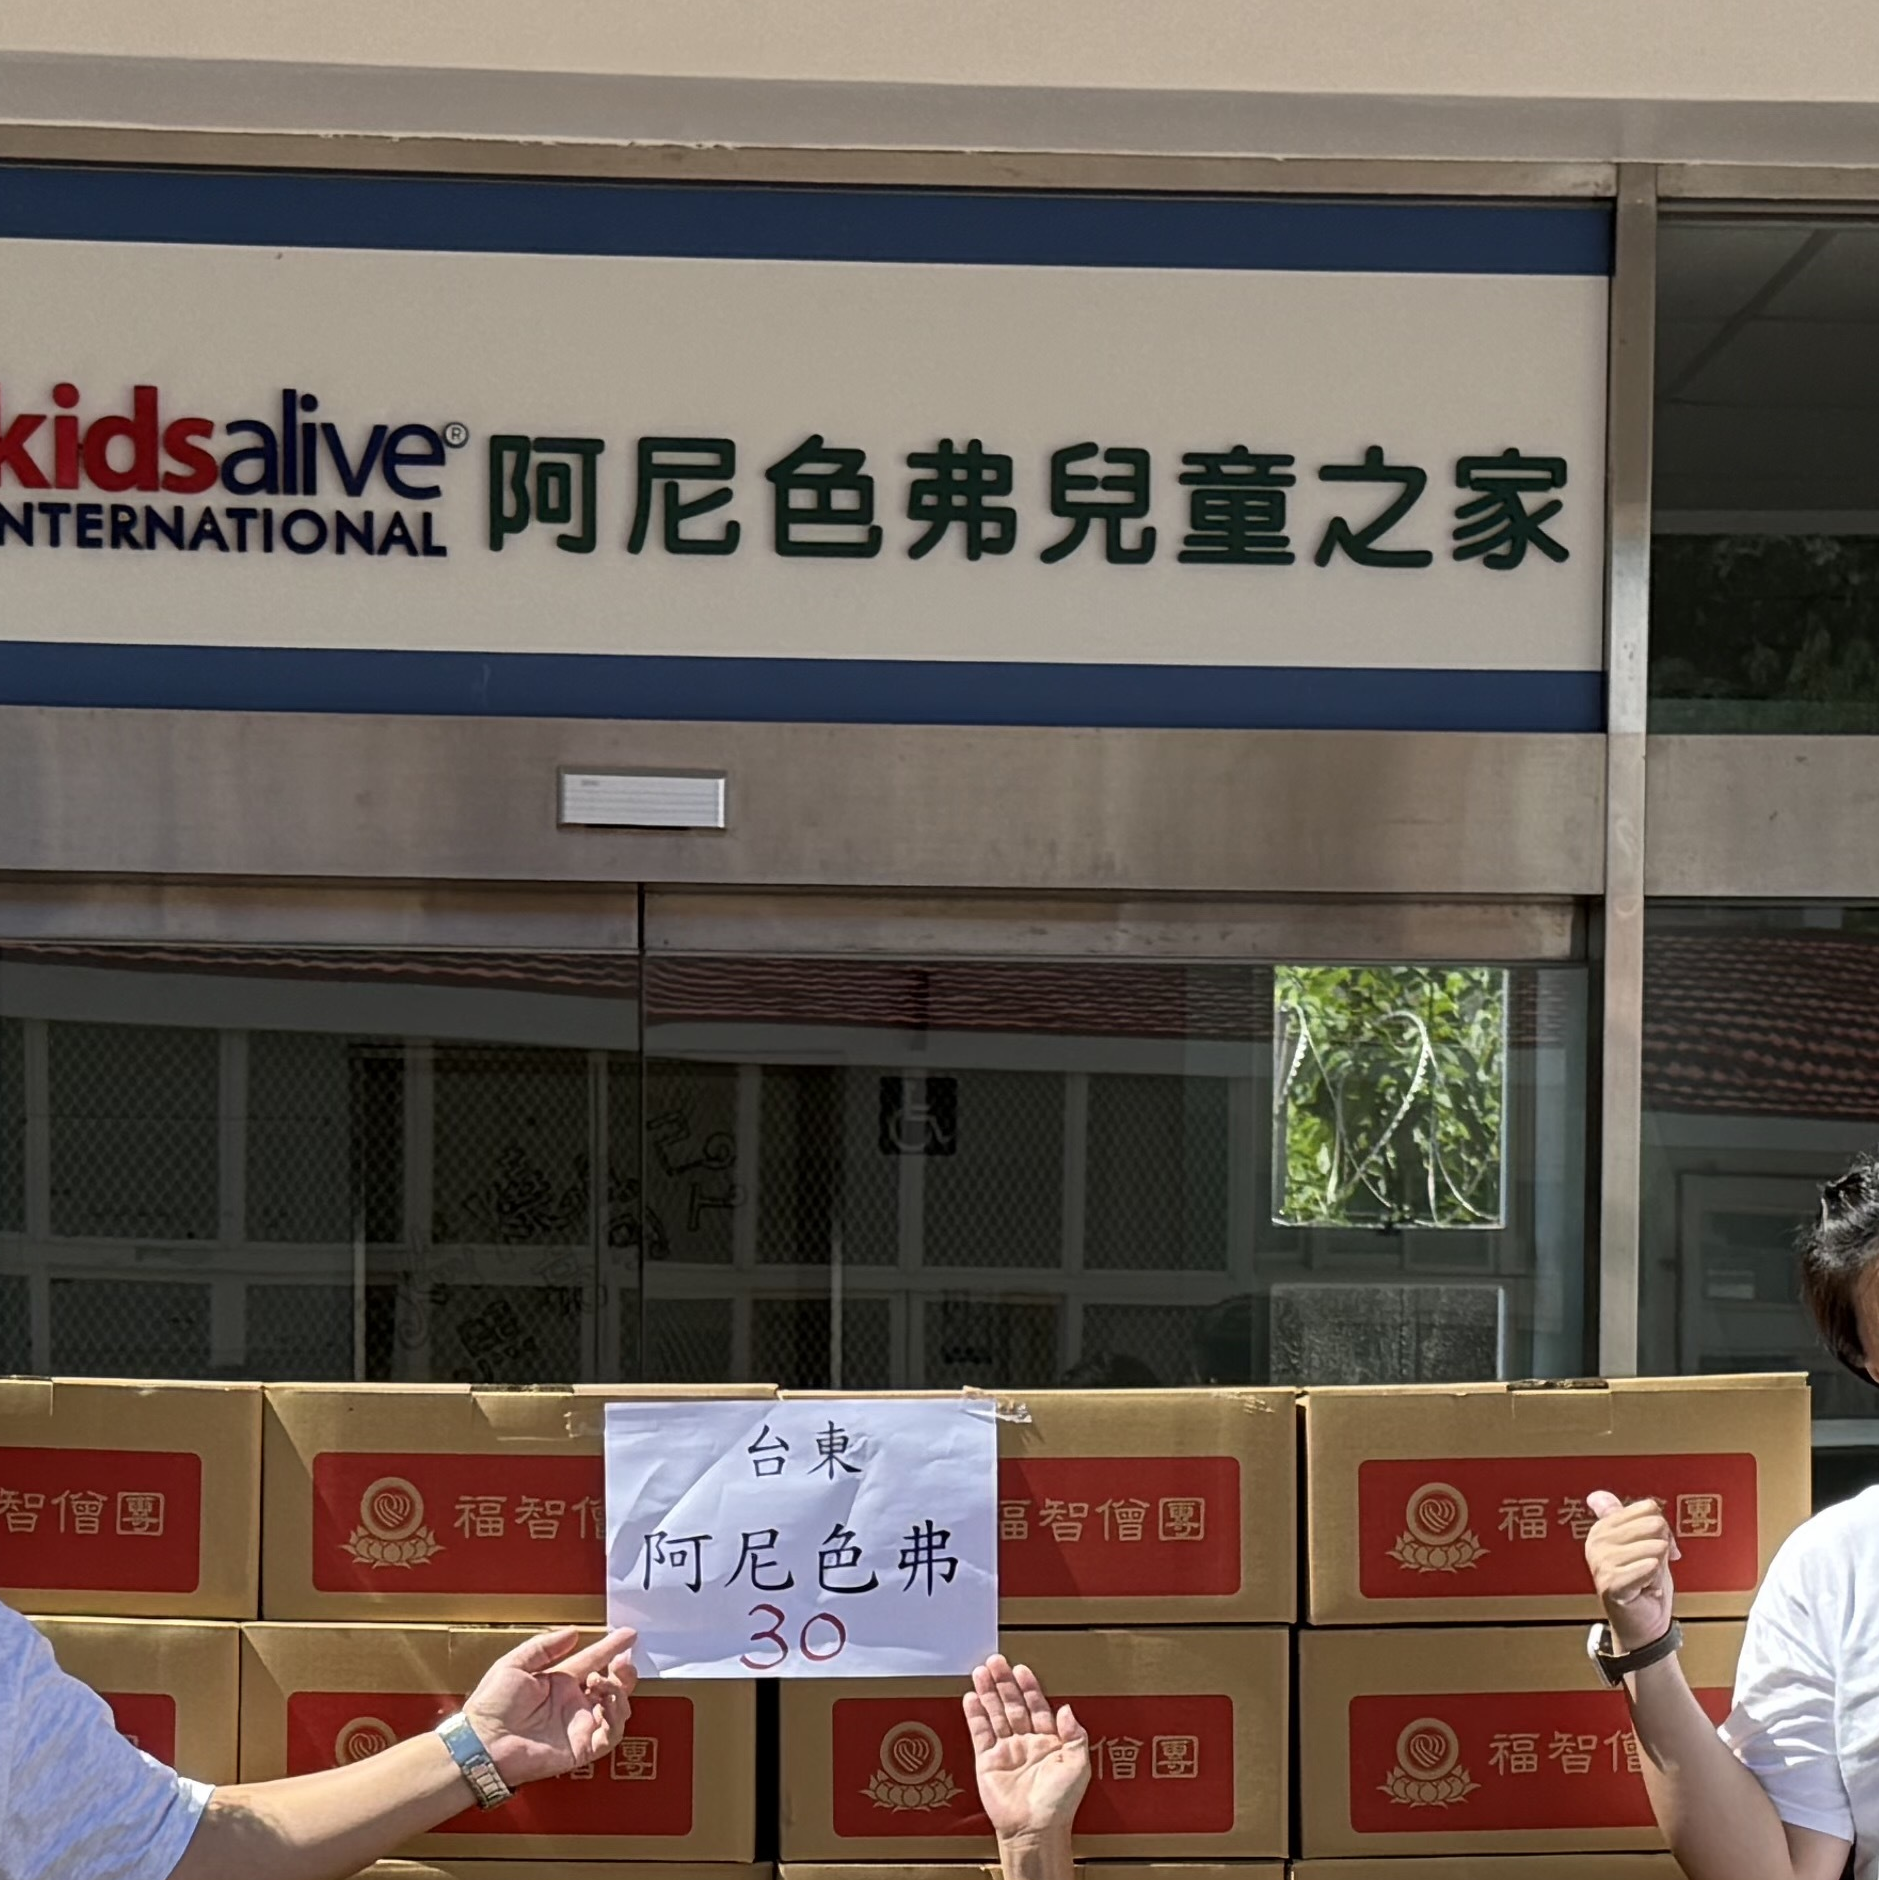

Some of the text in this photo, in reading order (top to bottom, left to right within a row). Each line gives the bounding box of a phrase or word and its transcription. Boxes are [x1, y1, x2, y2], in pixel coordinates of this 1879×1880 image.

[485, 433, 1573, 572] 阿尼色弗兒童之家
[745, 1420, 864, 1481] 台東
[641, 1518, 960, 1598] 阿尼色弗
[739, 1603, 848, 1671] 30
